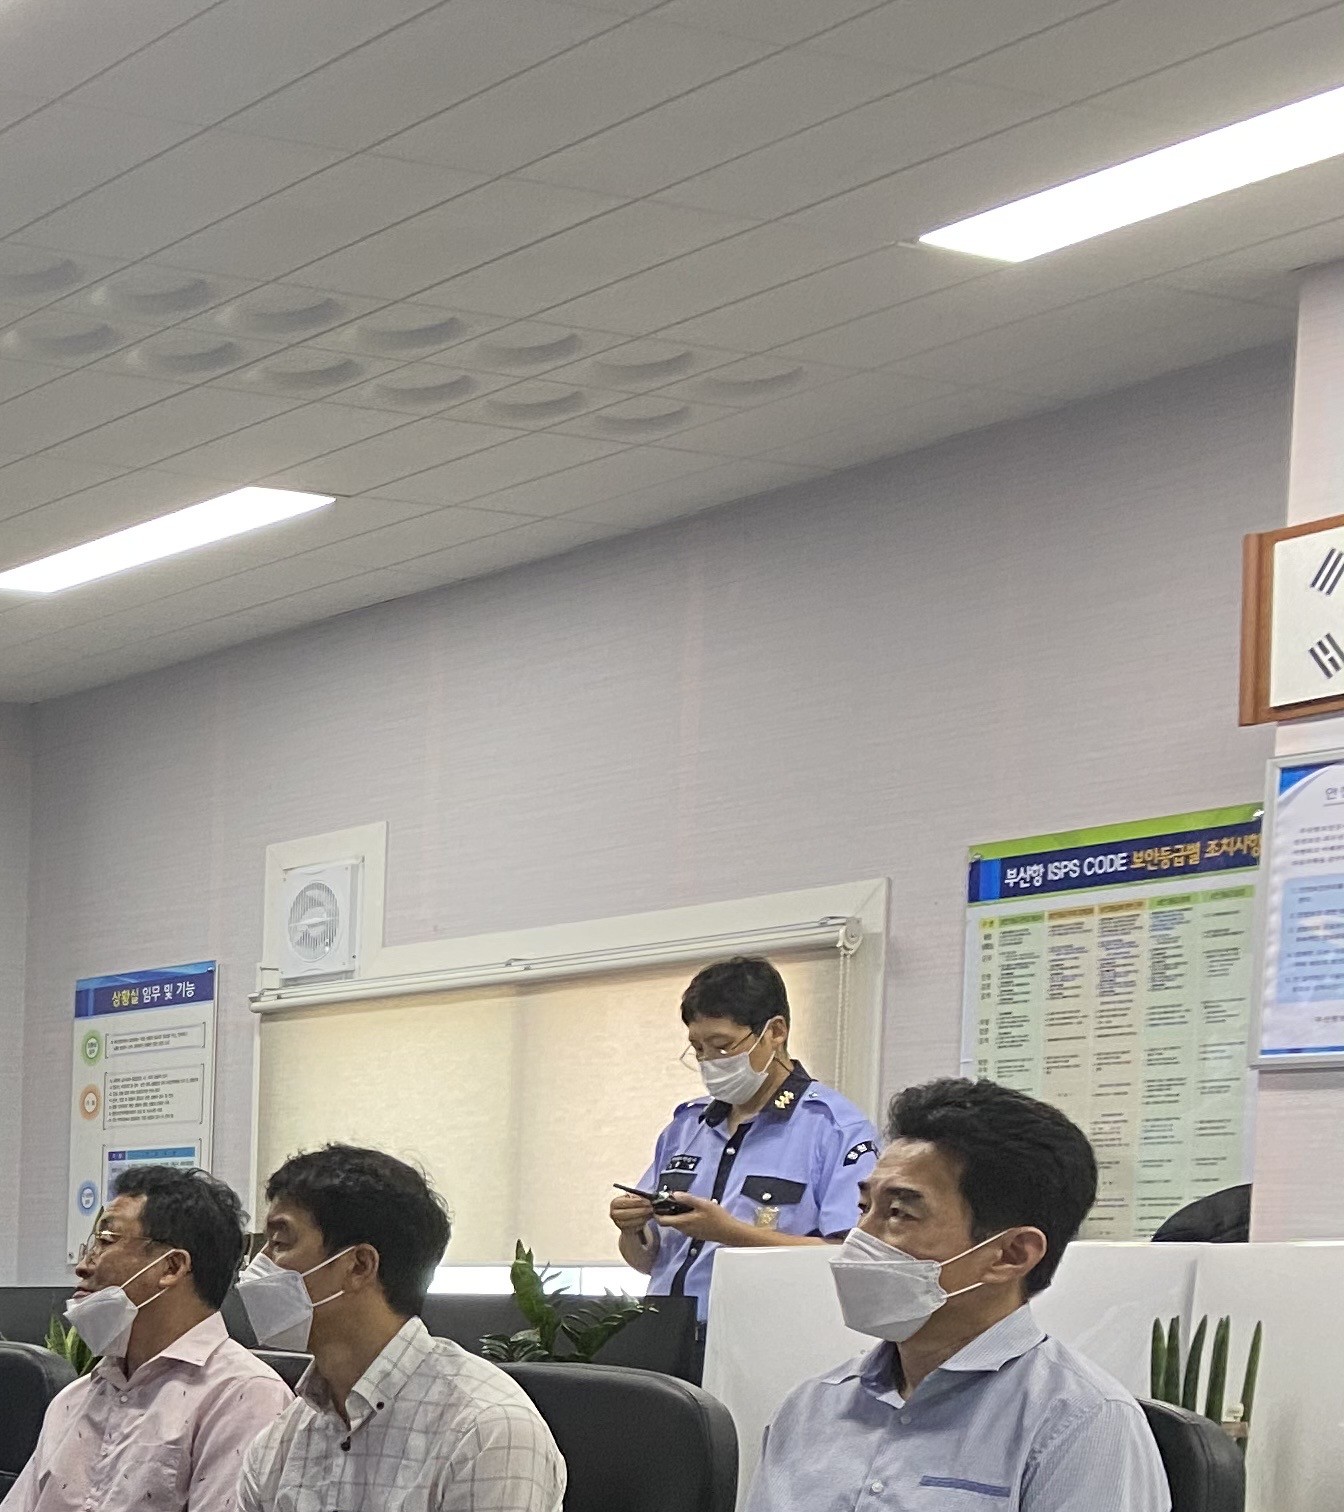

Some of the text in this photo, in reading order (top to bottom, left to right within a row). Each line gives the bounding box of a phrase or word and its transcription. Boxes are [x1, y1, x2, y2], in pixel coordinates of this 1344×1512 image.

[1004, 866, 1045, 888] 부산항
[1047, 859, 1080, 880] ISPS
[1083, 853, 1128, 876] CODE
[1130, 841, 1201, 871] 보안등급별
[112, 982, 195, 1008] 상황실 임무 및 기능
